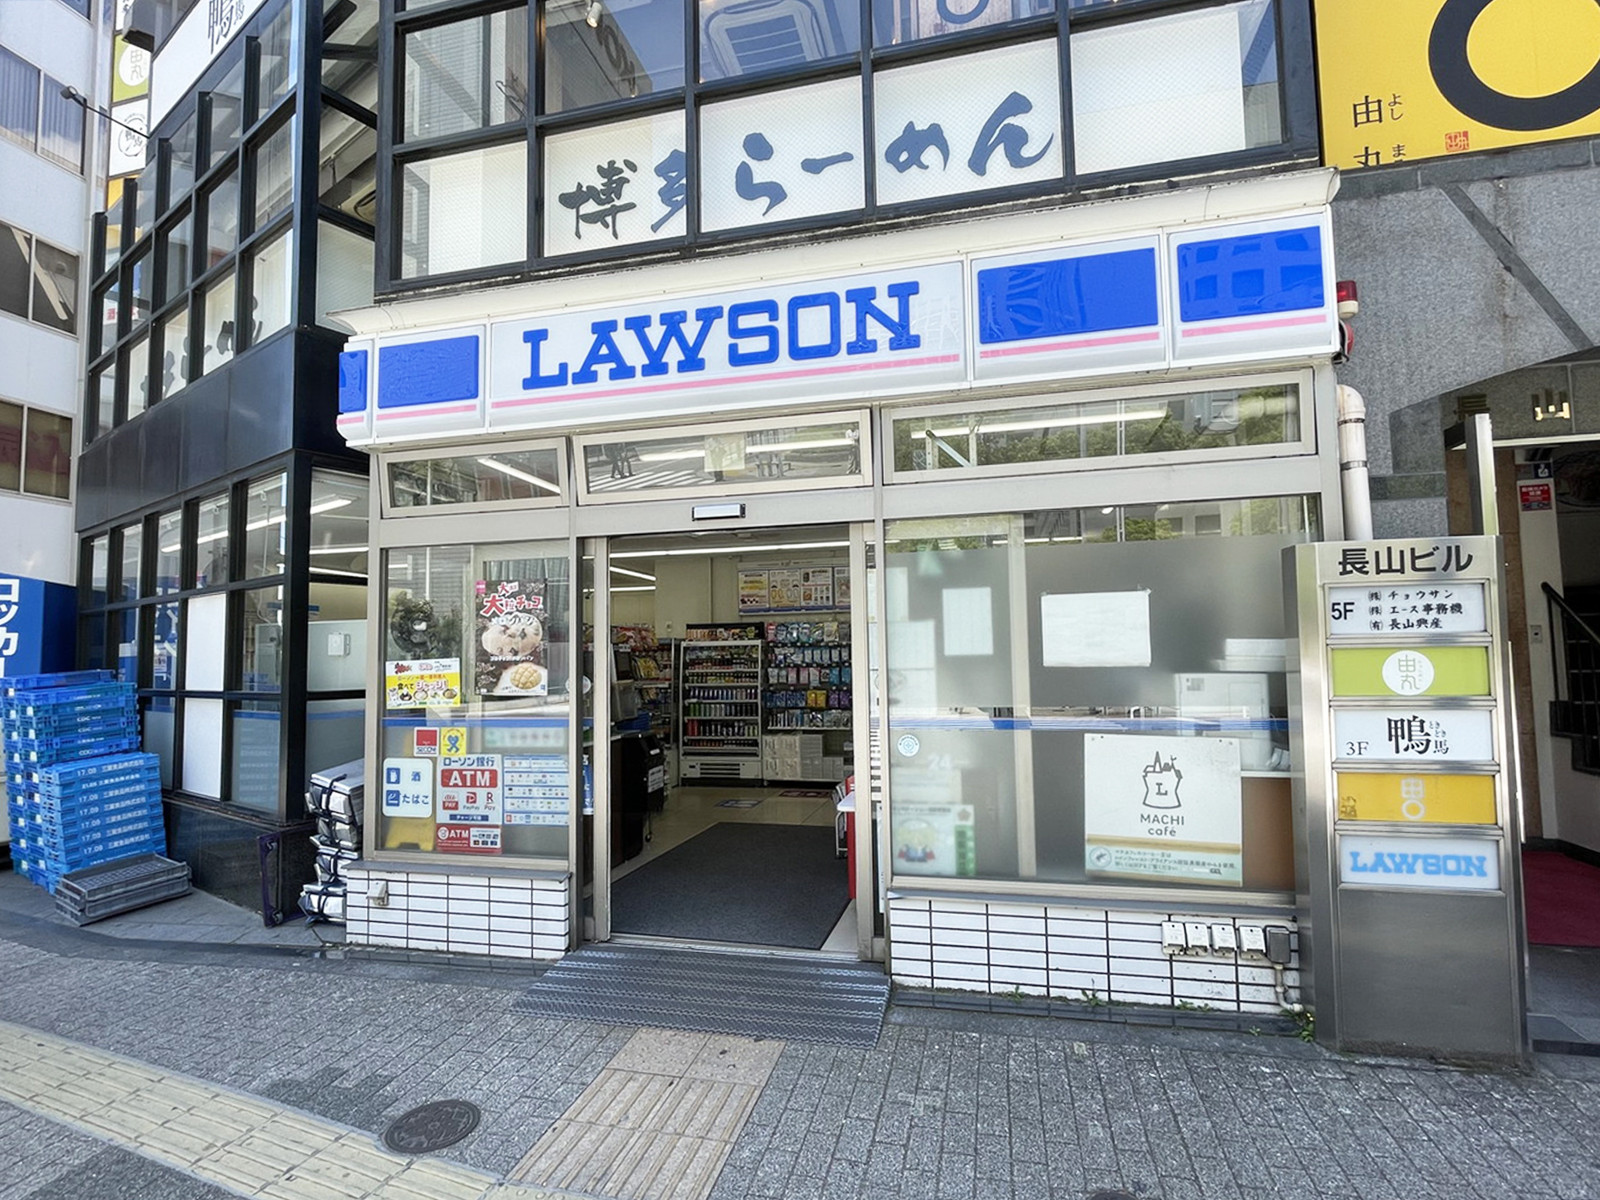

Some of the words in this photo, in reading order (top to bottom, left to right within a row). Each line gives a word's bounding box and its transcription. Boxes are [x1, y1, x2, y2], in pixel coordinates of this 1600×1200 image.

[558, 91, 1054, 240] 博多らーめん
[522, 280, 920, 390] LAWSON
[1338, 545, 1473, 576] 長山ビル
[1388, 590, 1453, 600] チョウサン
[1331, 602, 1355, 620] 5F
[1390, 602, 1463, 615] エース事務機
[1389, 617, 1443, 631] 長山興産
[1387, 715, 1431, 754] 鴨
[1346, 741, 1369, 756] 3F
[444, 756, 495, 767] ローソン銀行
[449, 770, 491, 787] ATM
[1140, 813, 1185, 826] MACHI
[449, 829, 469, 838] ATM
[1147, 826, 1177, 837] café
[1350, 851, 1488, 878] LAWSON
